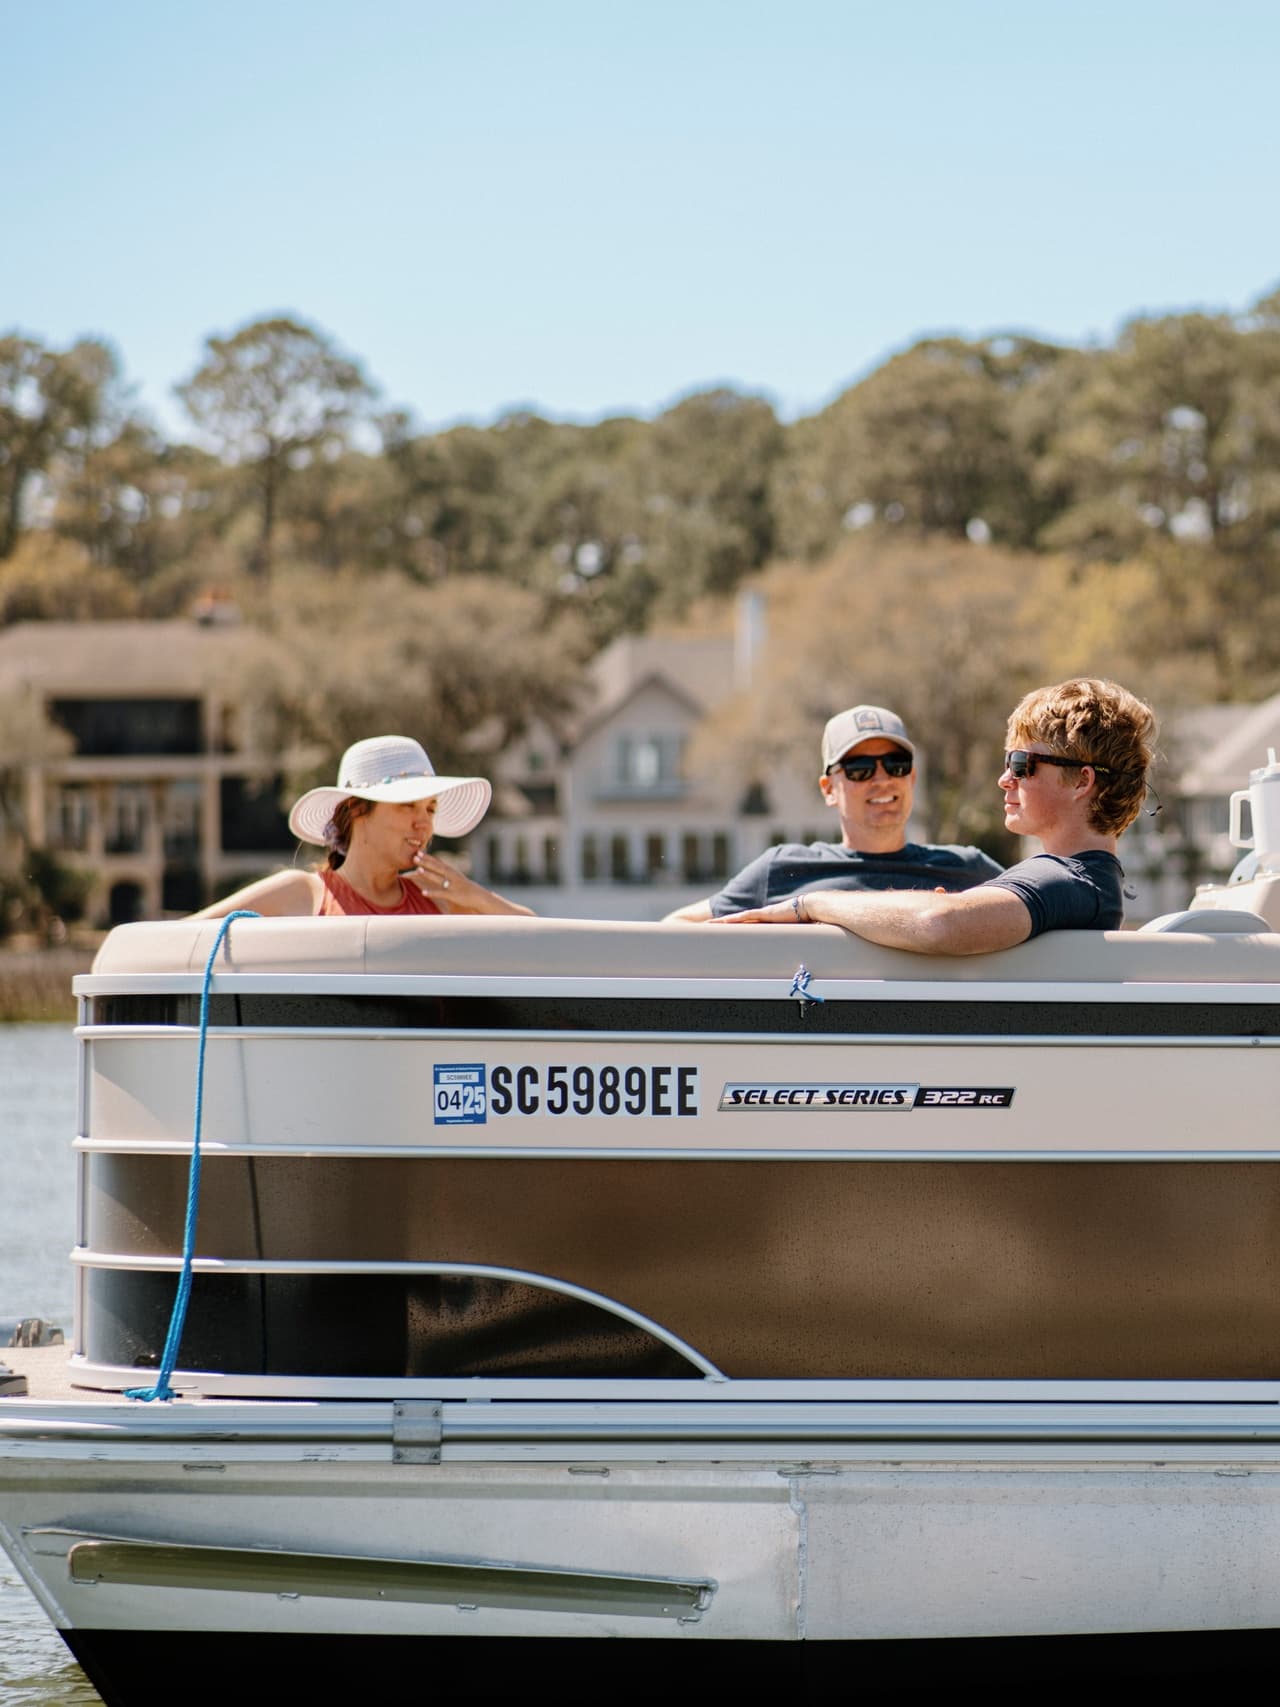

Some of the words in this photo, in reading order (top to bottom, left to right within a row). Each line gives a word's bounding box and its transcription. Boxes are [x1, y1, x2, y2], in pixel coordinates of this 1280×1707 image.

[437, 1090, 462, 1111] 04
[491, 1066, 698, 1116] SC5989EE
[728, 1089, 819, 1105] SELECT
[822, 1089, 908, 1105] SERIES
[923, 1091, 975, 1105] 322
[978, 1096, 1004, 1105] RC
